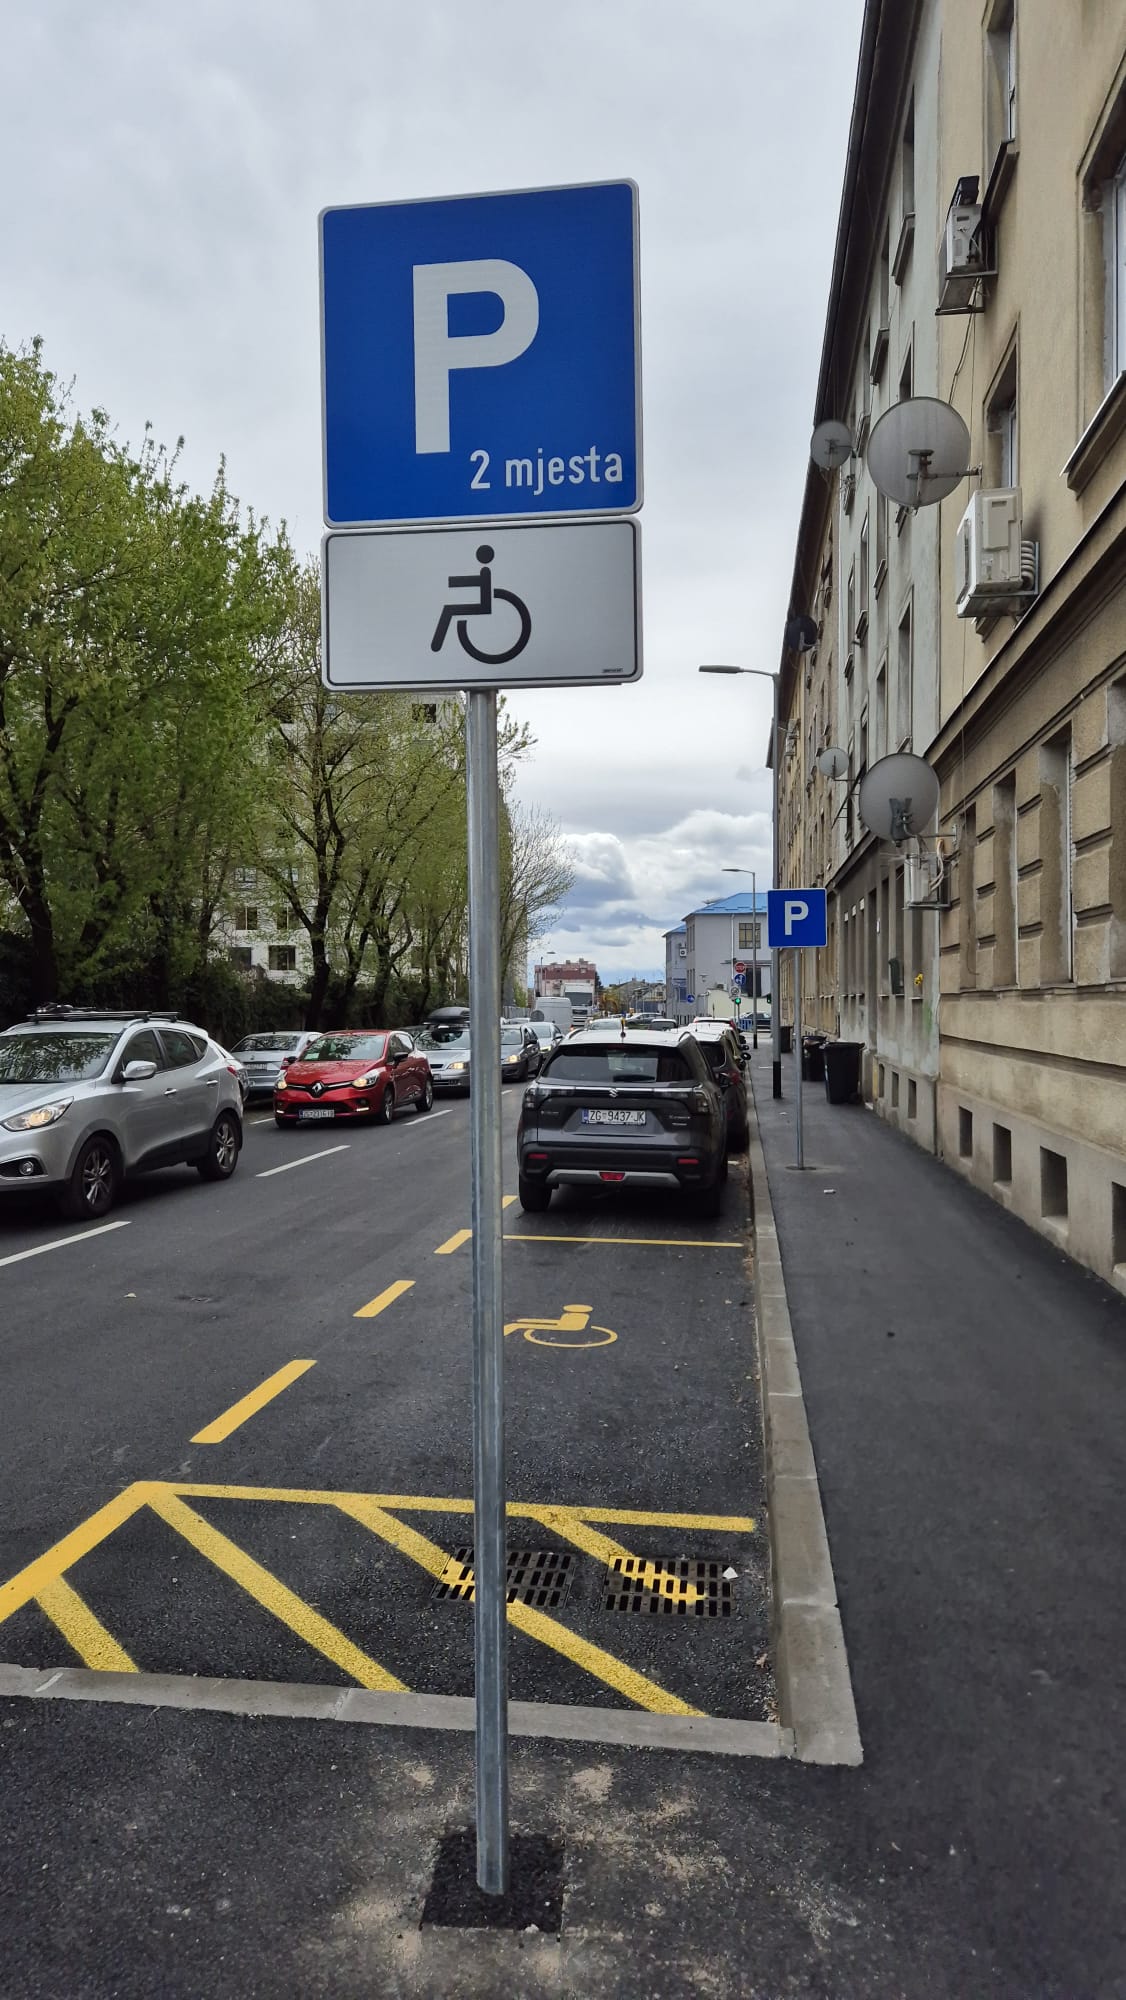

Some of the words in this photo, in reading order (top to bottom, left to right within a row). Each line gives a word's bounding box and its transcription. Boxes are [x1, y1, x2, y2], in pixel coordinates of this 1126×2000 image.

[413, 259, 539, 454] P
[470, 450, 490, 490] 2
[505, 445, 623, 496] mjesta
[785, 901, 808, 935] P
